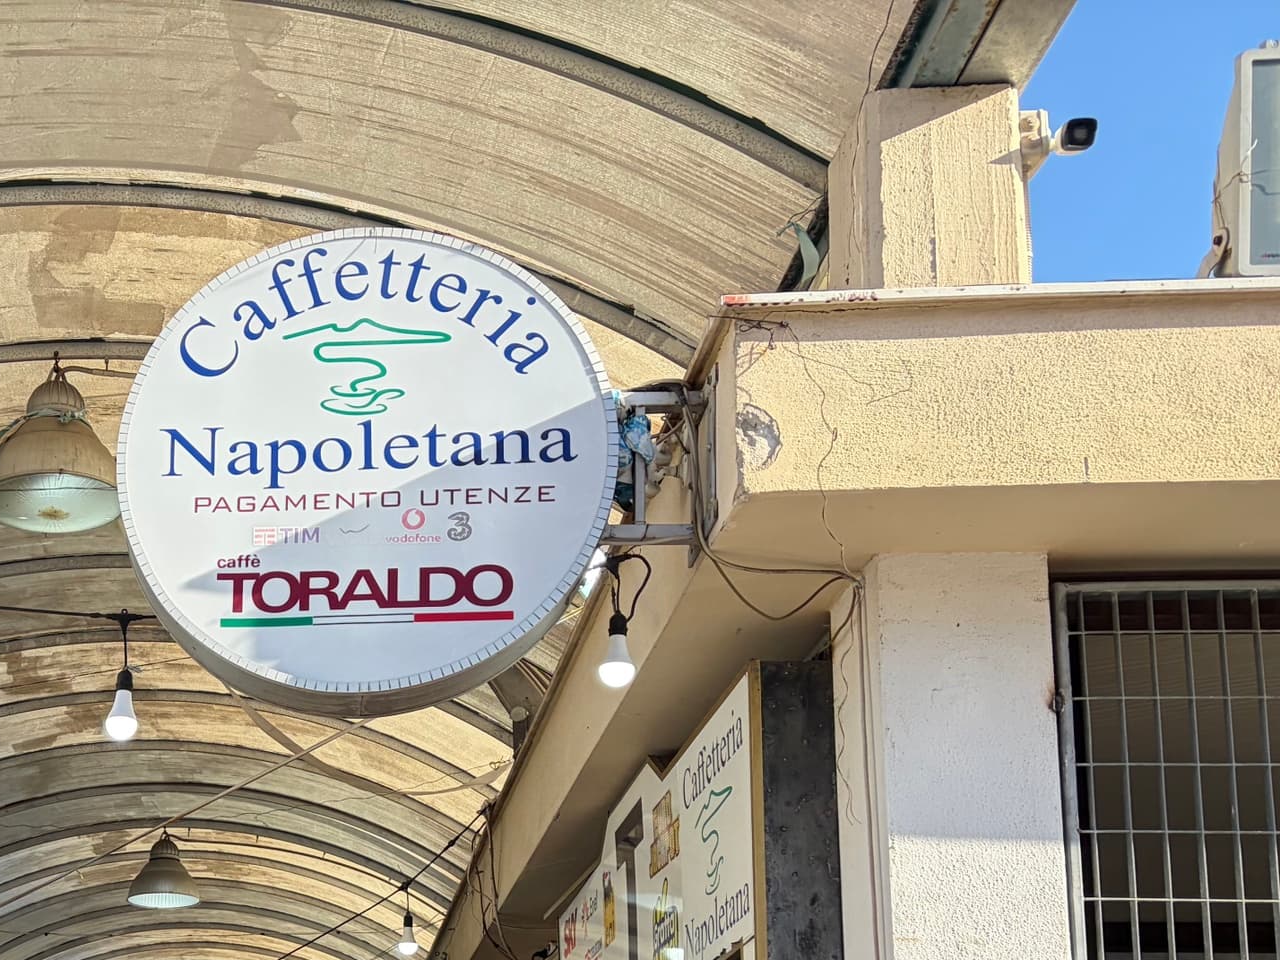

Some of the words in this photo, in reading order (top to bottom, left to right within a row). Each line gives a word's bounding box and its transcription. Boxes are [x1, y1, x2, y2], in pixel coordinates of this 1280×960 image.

[179, 248, 550, 377] Caffetteria
[161, 419, 579, 490] Napoletana
[194, 491, 401, 513] PAGAMENTO
[420, 485, 556, 507] UTENZE
[280, 526, 320, 545] TIM
[385, 533, 442, 545] vodafone
[447, 512, 473, 542] 3
[216, 554, 262, 569] caffè
[216, 564, 514, 614] TORALDO
[682, 709, 743, 810] Caffetteria
